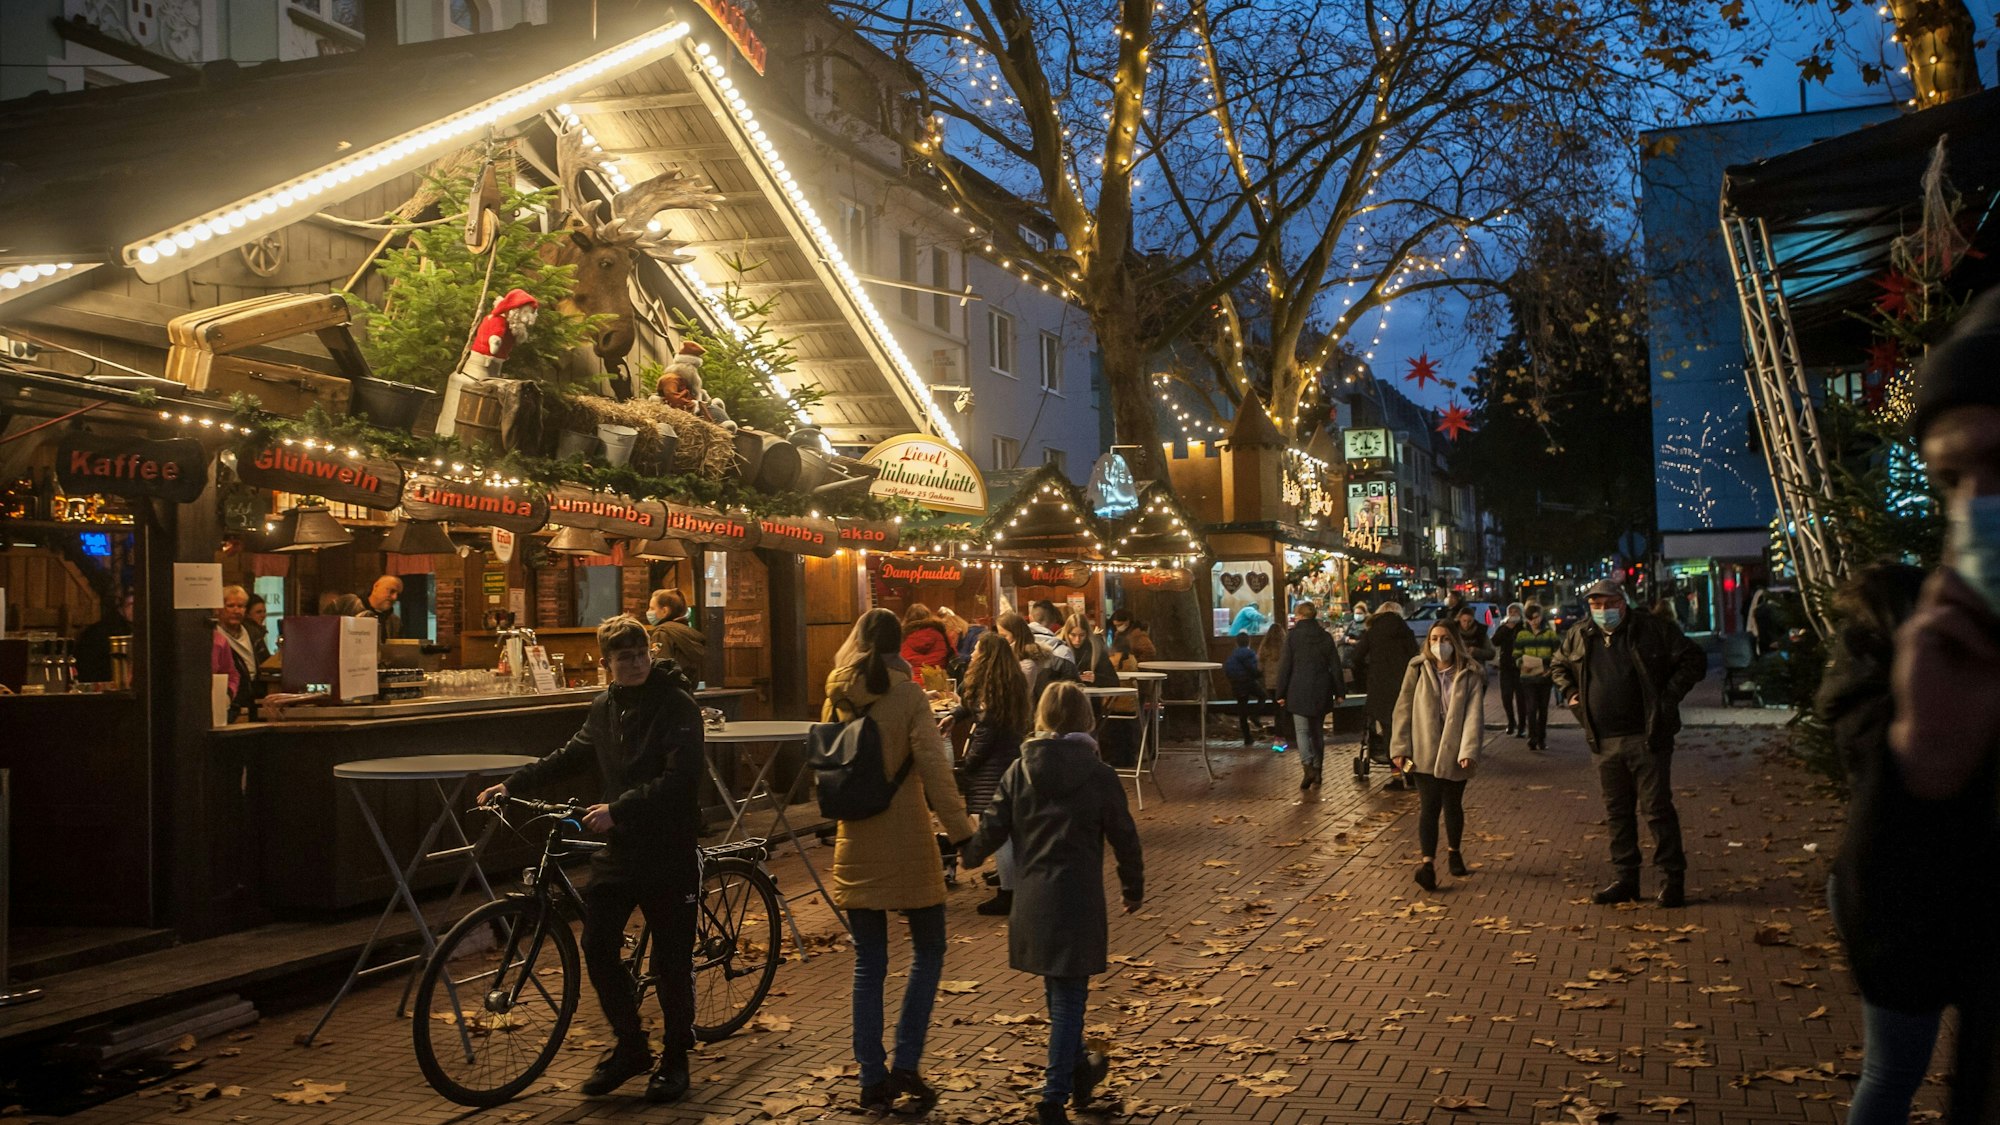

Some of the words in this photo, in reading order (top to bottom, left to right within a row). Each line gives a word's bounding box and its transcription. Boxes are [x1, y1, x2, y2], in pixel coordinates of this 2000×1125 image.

[69, 449, 180, 481] Kaffee
[899, 445, 949, 468] Liesel's
[254, 447, 379, 493] Glühwein
[413, 483, 532, 517] Lumumba
[928, 491, 955, 501] Jahren
[547, 493, 653, 526] Lumumba
[667, 510, 745, 537] lühwein
[760, 519, 825, 545] mumba
[840, 527, 886, 542] akao
[883, 563, 960, 584] Dampfnudeln
